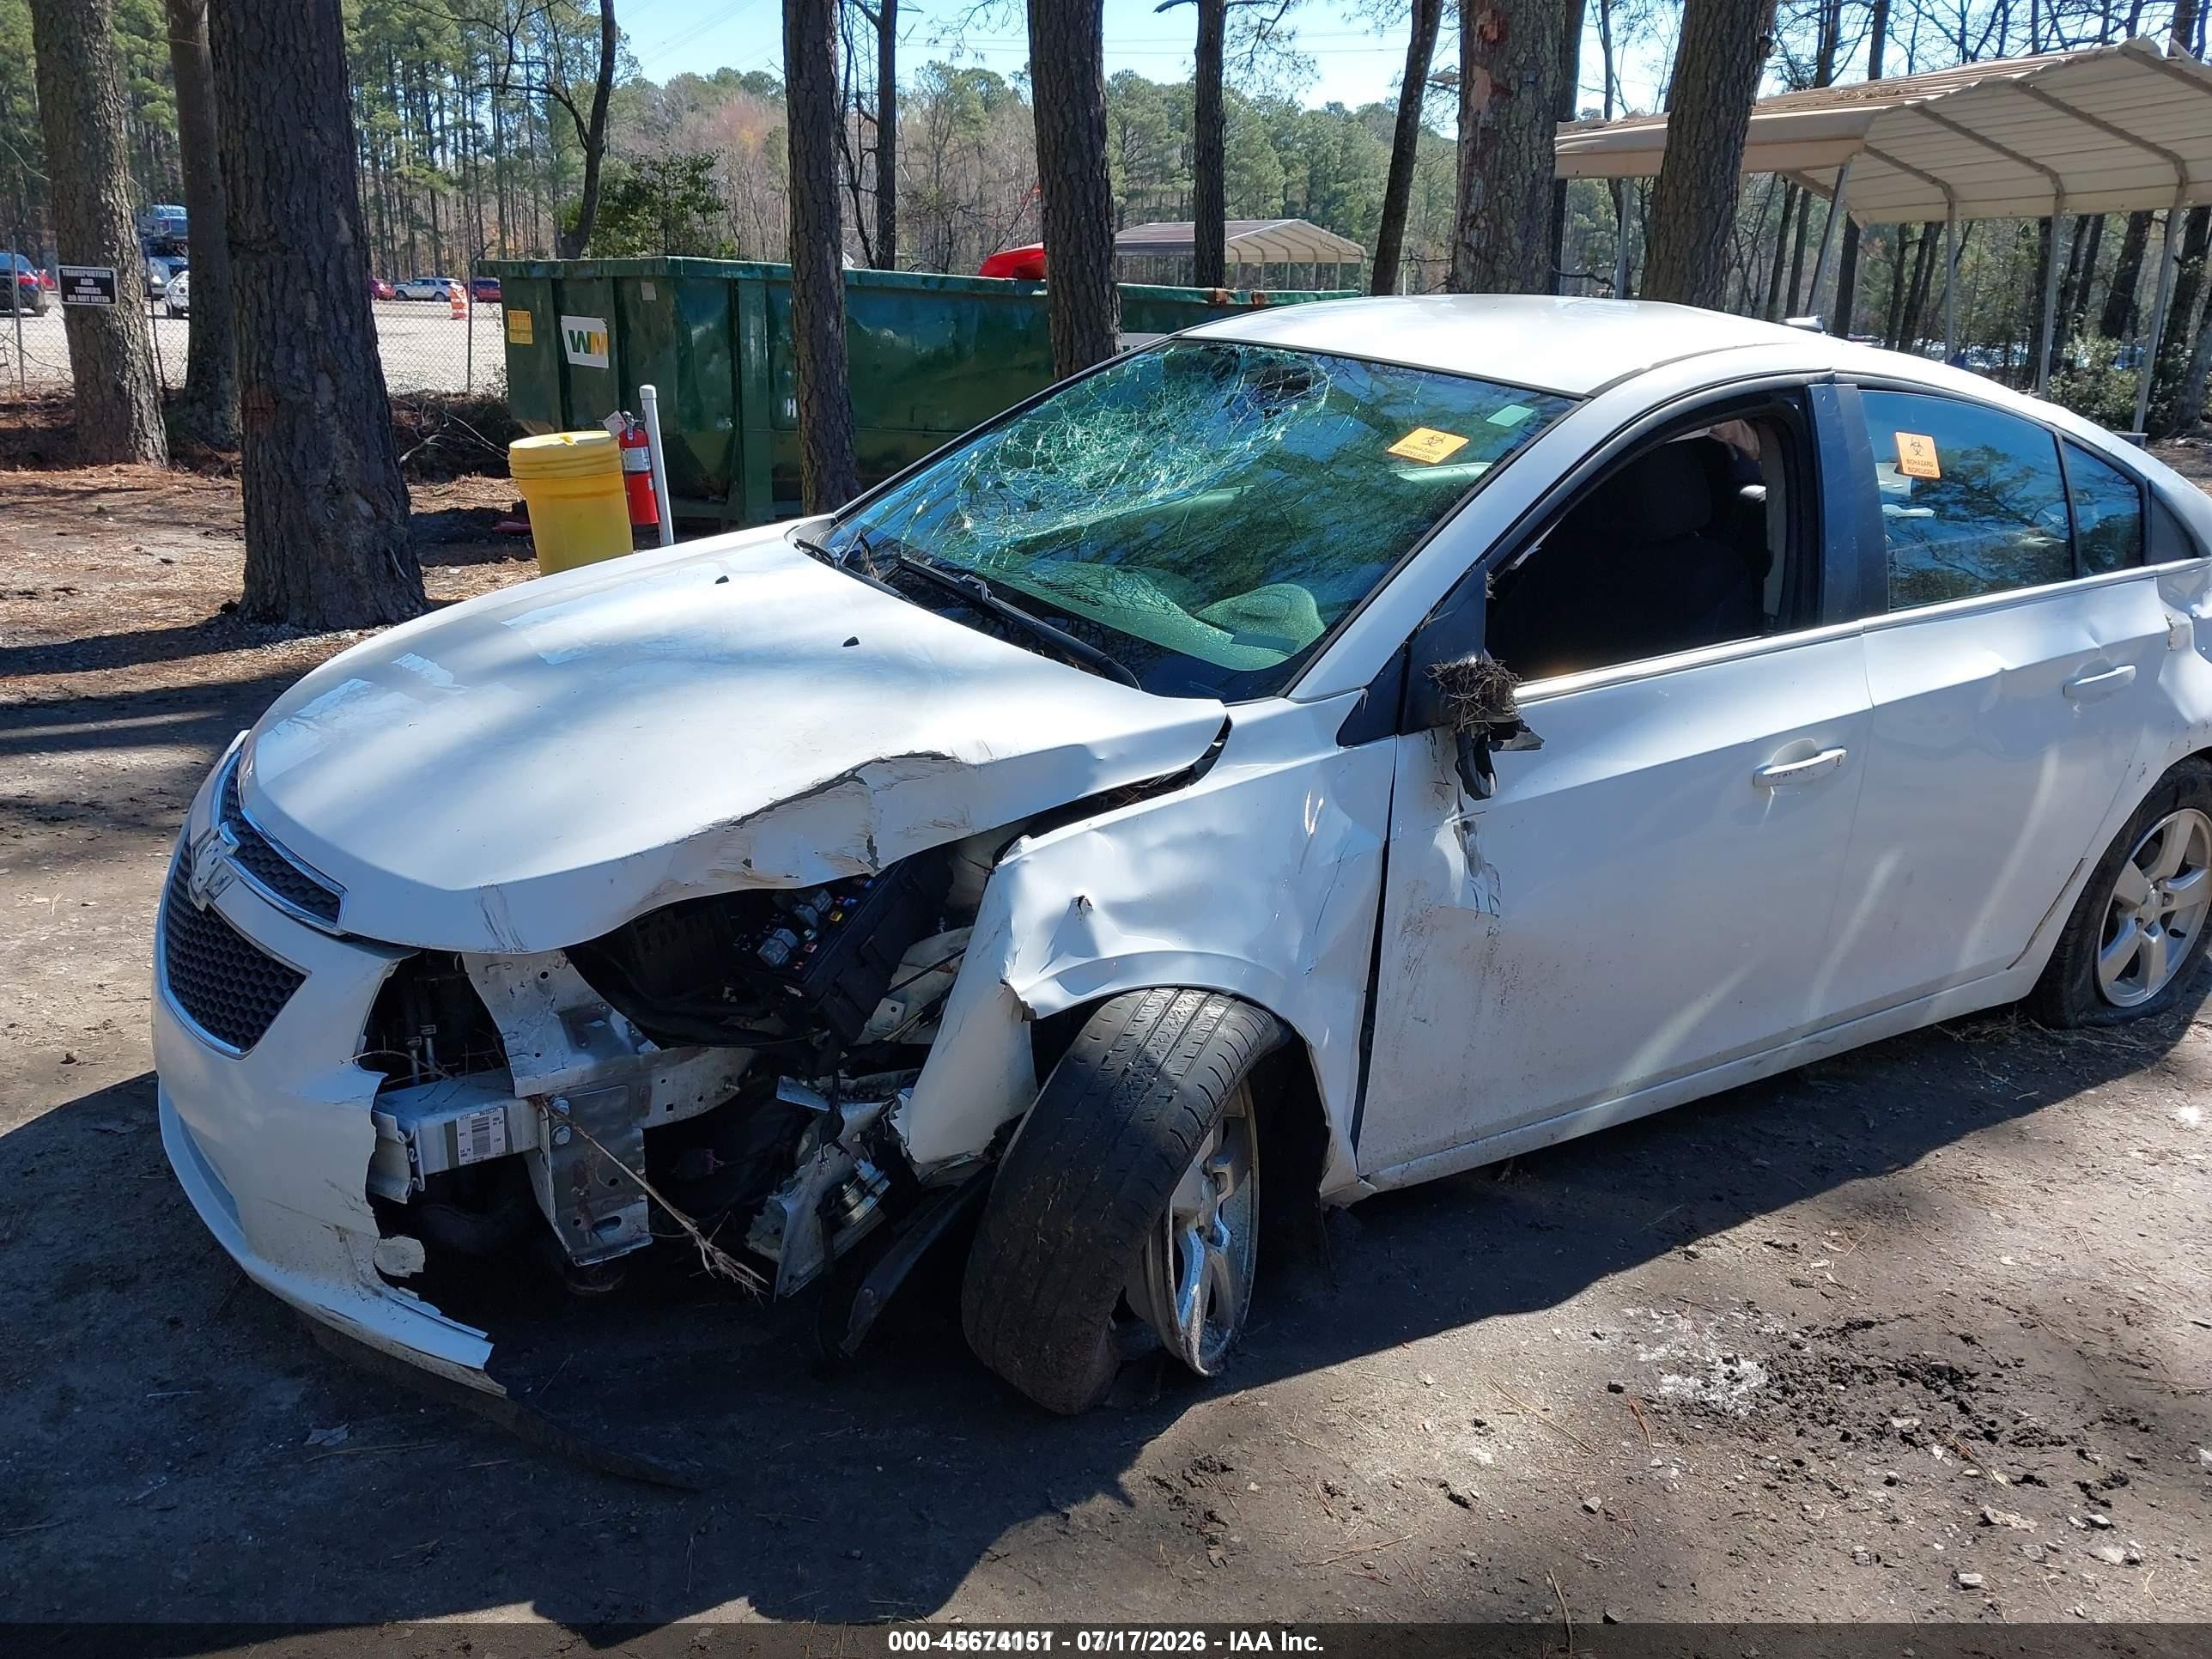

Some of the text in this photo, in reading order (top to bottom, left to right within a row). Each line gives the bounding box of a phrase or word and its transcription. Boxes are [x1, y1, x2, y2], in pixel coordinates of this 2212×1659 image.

[62, 269, 112, 278] TRANSPORTERS
[80, 277, 94, 286] AND
[568, 329, 608, 356] WM
[1906, 459, 1934, 468] BIOHAZARD
